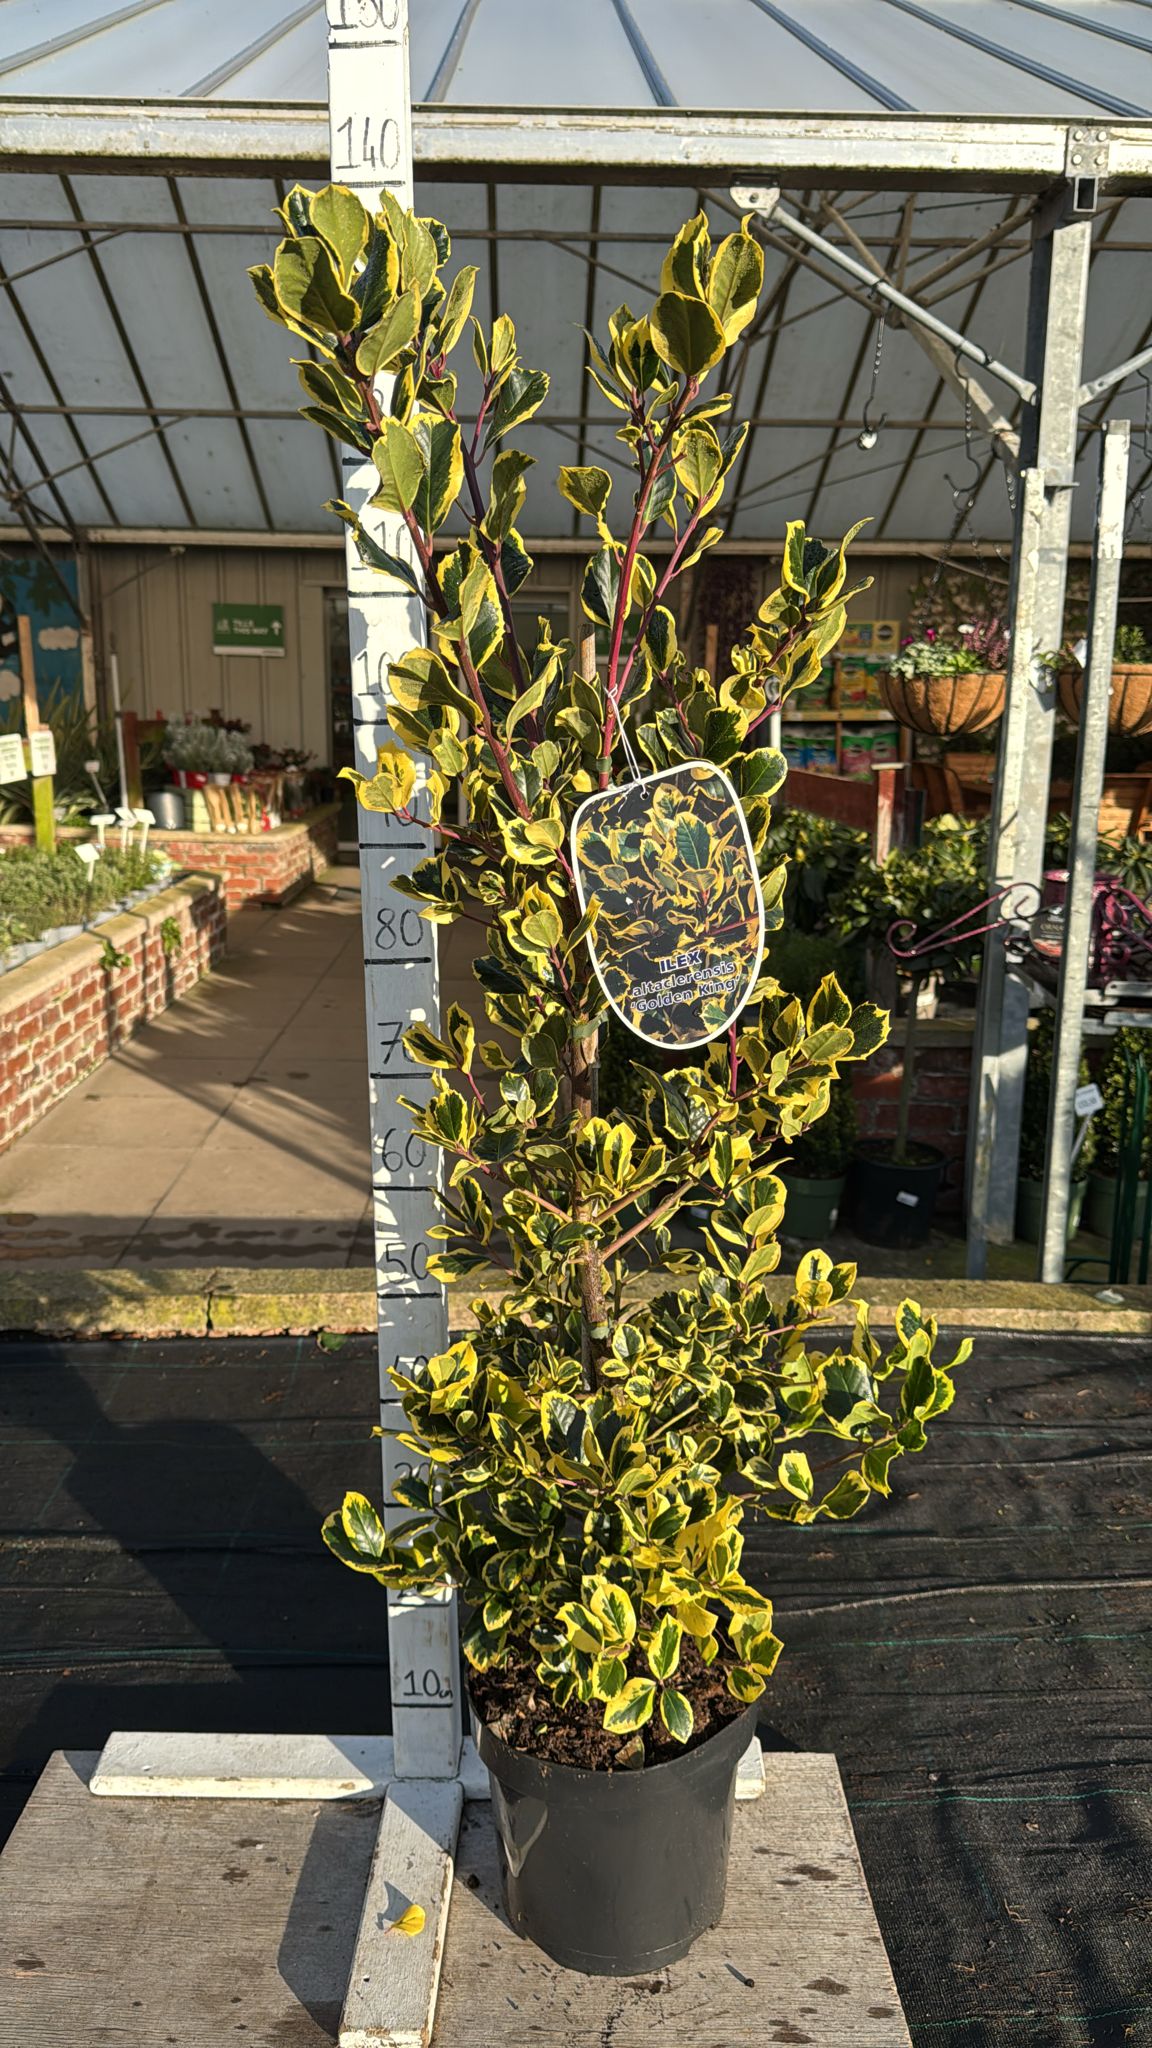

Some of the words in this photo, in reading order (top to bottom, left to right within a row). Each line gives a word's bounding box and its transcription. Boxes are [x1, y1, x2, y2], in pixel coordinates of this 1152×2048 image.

[335, 116, 400, 170] 140
[375, 907, 424, 950] 80
[632, 961, 737, 997] altaclerensis
[659, 950, 703, 974] ILEX
[382, 1128, 427, 1172] 60
[386, 1242, 430, 1284] 50
